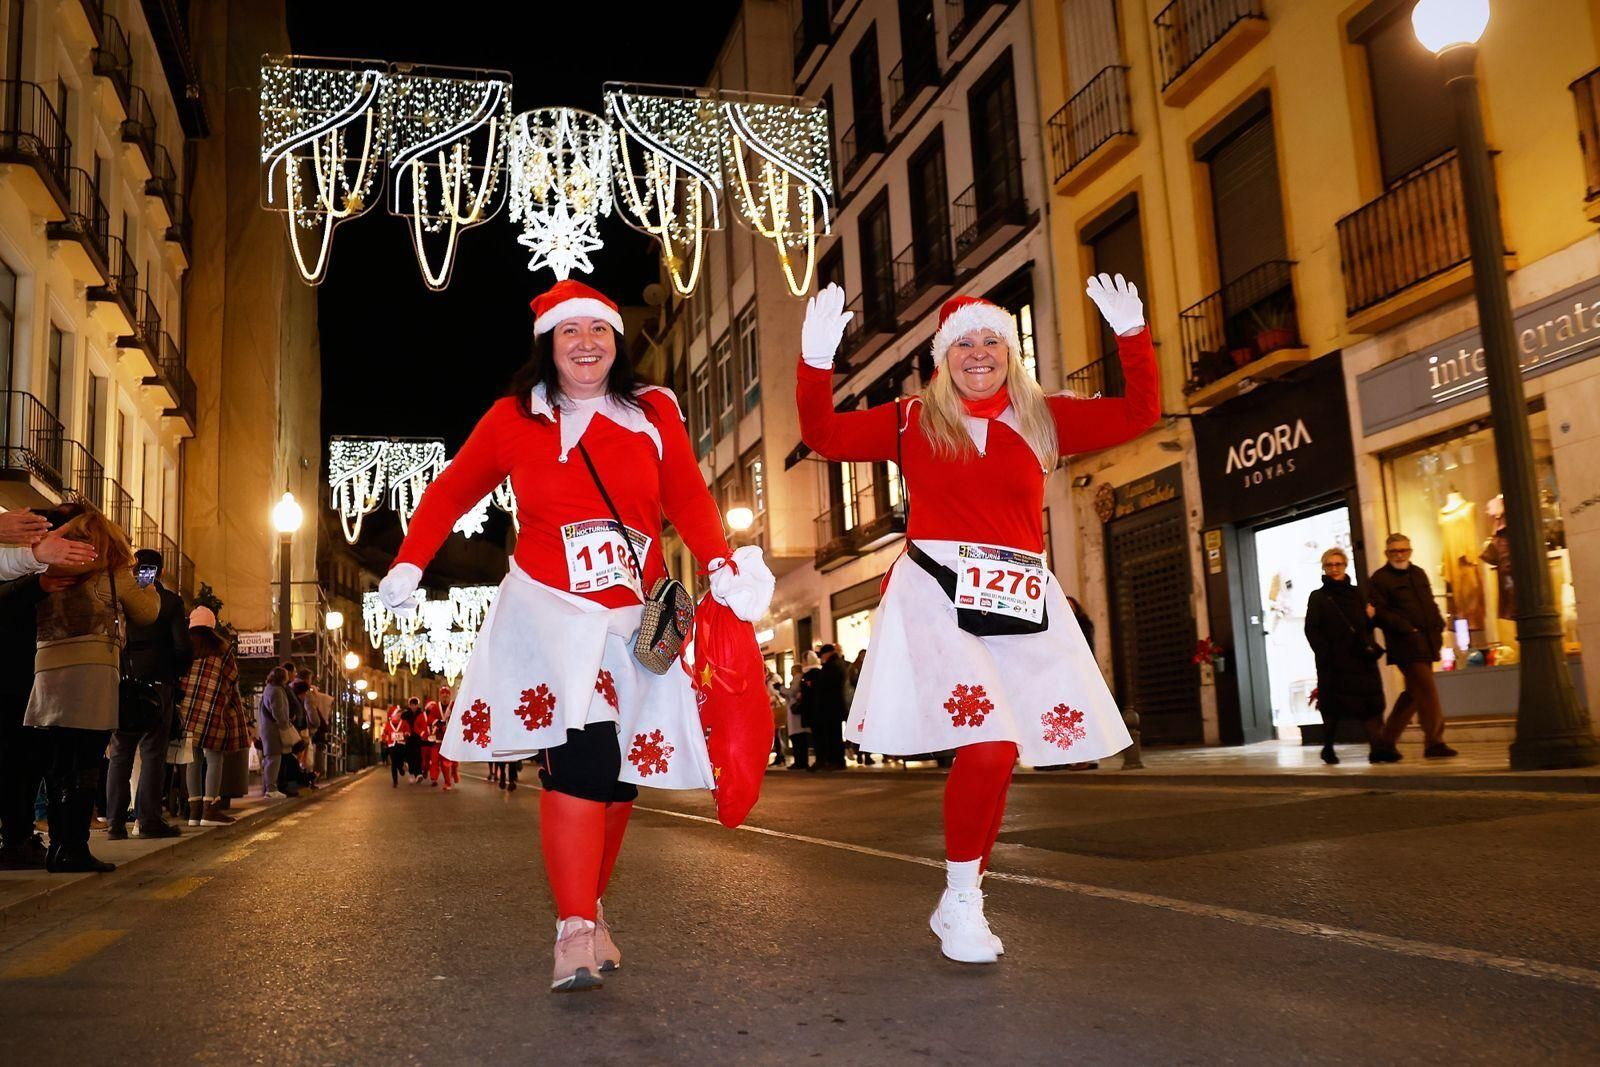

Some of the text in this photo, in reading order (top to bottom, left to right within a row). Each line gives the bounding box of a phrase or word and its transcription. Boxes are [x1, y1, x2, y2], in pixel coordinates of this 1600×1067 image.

[1225, 418, 1313, 475] AGORA
[1243, 458, 1297, 489] JOYAS
[576, 526, 610, 537] NOCTURNA
[966, 566, 1042, 600] 1276
